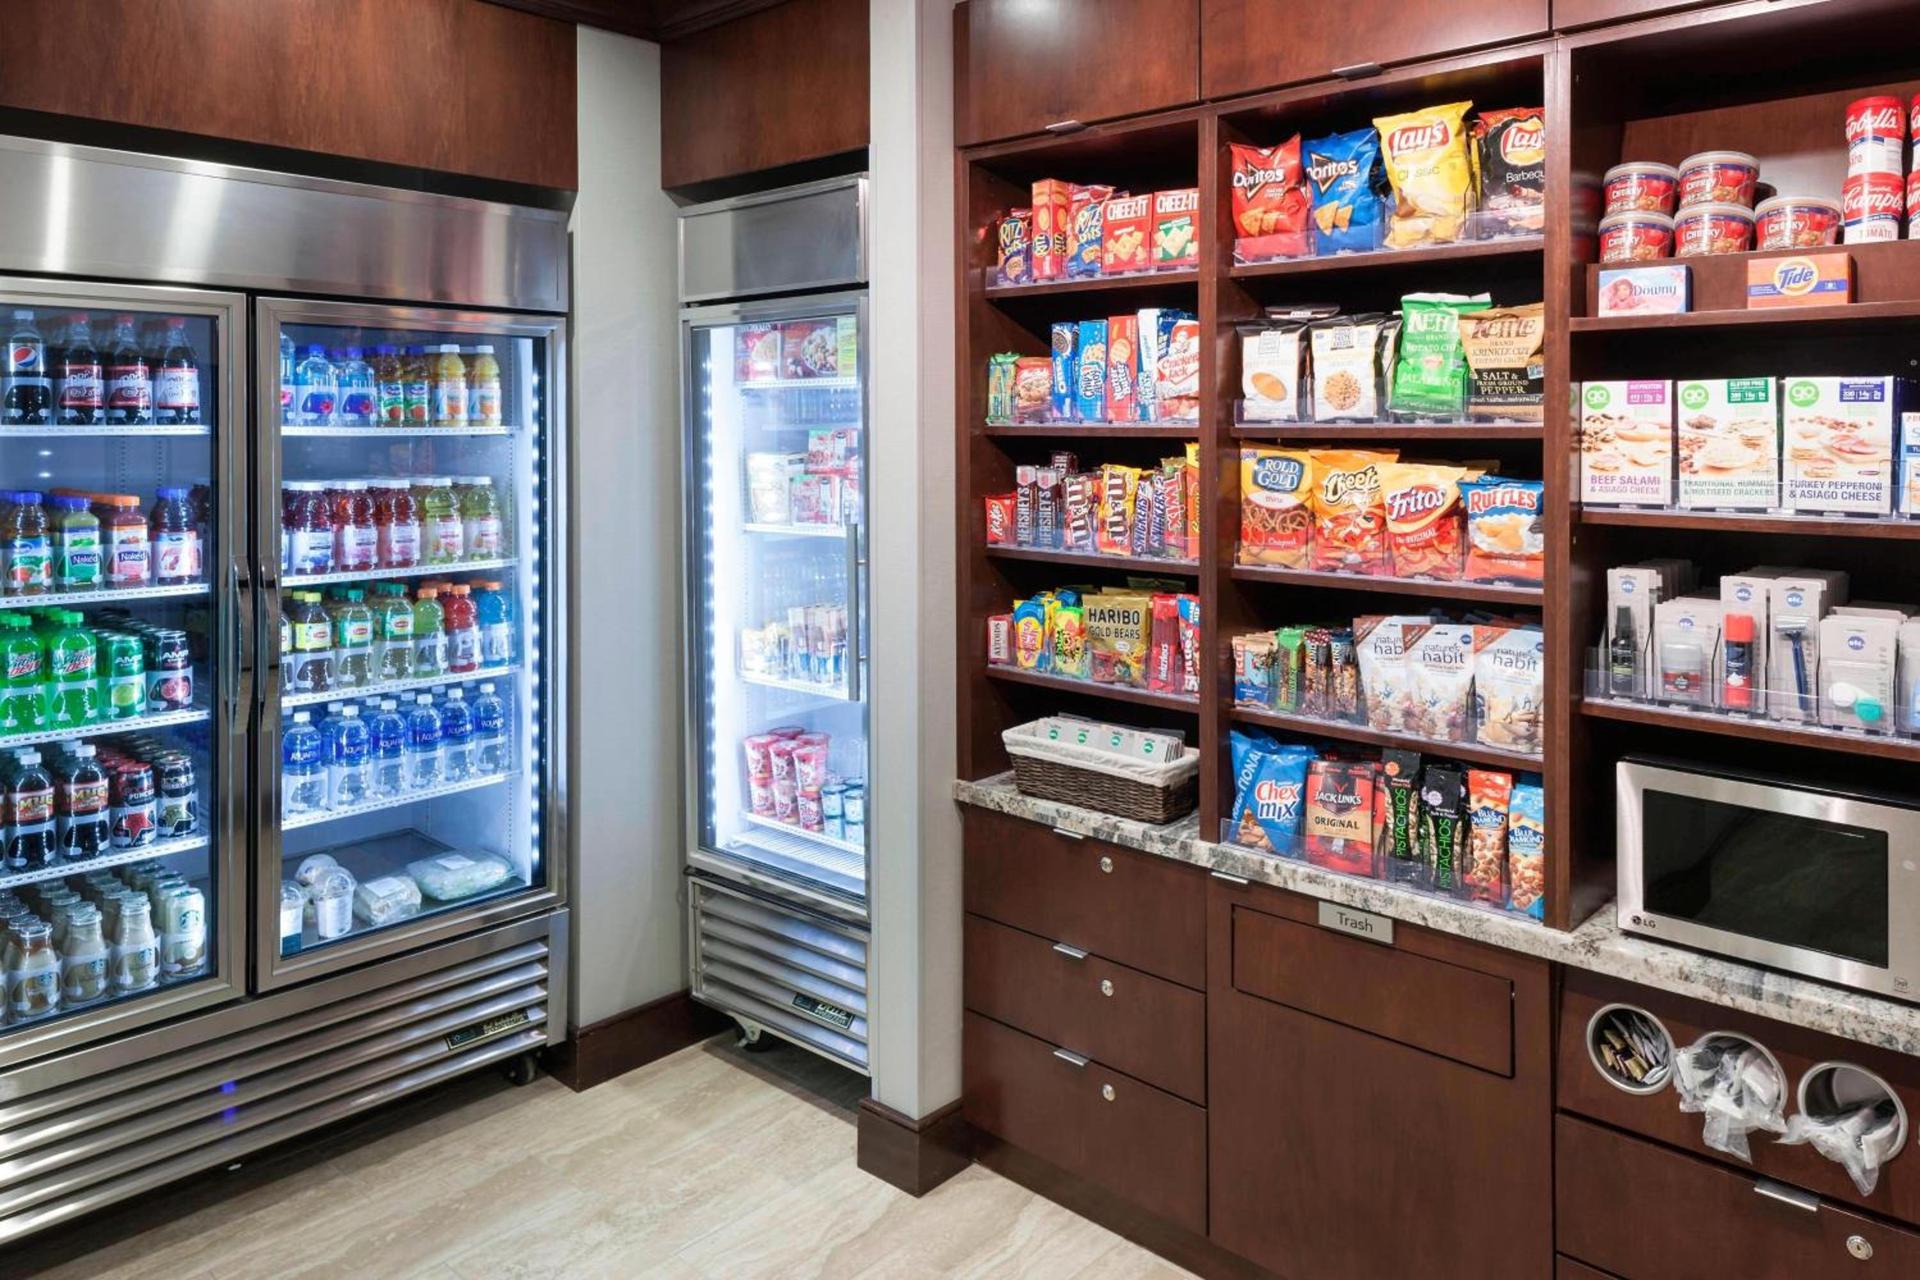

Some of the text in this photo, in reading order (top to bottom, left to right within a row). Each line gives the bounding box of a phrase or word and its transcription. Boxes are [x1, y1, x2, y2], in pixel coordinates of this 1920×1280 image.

[1389, 117, 1446, 156] Lay's
[1233, 168, 1285, 188] Doritos
[1106, 199, 1149, 221] CHEEZ-IT
[1156, 191, 1199, 213] CHEEZ-IT
[999, 220, 1024, 248] RITZ
[1033, 234, 1050, 256] RITZ
[1778, 267, 1814, 289] Tide
[1631, 283, 1677, 296] Downy
[1482, 371, 1519, 380] SALT &
[1480, 386, 1527, 395] PEPPER
[1265, 458, 1299, 475] ROLD
[1257, 470, 1298, 489] GOLD
[1591, 475, 1661, 485] BEEF SALAMI
[1790, 480, 1882, 490] TURKEY PEPPERONI
[1163, 472, 1185, 532] TWIX
[1387, 485, 1447, 521] Fritos
[1469, 487, 1538, 514] RUFFLES
[1800, 490, 1838, 499] ASIAGO
[1841, 491, 1882, 501] CHEESE
[1134, 494, 1149, 552] SNICKERS
[1151, 488, 1166, 547] SNICKERS
[121, 552, 146, 562] Naked
[1088, 607, 1141, 626] HARIBO
[1088, 626, 1141, 640] GOLD BEARS
[1307, 643, 1317, 665] KIND
[1332, 642, 1342, 665] KIND
[1422, 649, 1465, 665] habit
[1493, 652, 1539, 671] habit
[1256, 779, 1302, 803] Chex
[1315, 790, 1337, 804] JACK
[1314, 815, 1361, 830] ORIGINAL
[1395, 787, 1408, 857] PISTACHIOS
[1477, 808, 1497, 818] BLUE
[1439, 818, 1452, 889] PISTACHIOS
[1336, 910, 1374, 933] Trash
[1642, 919, 1656, 929] LG
